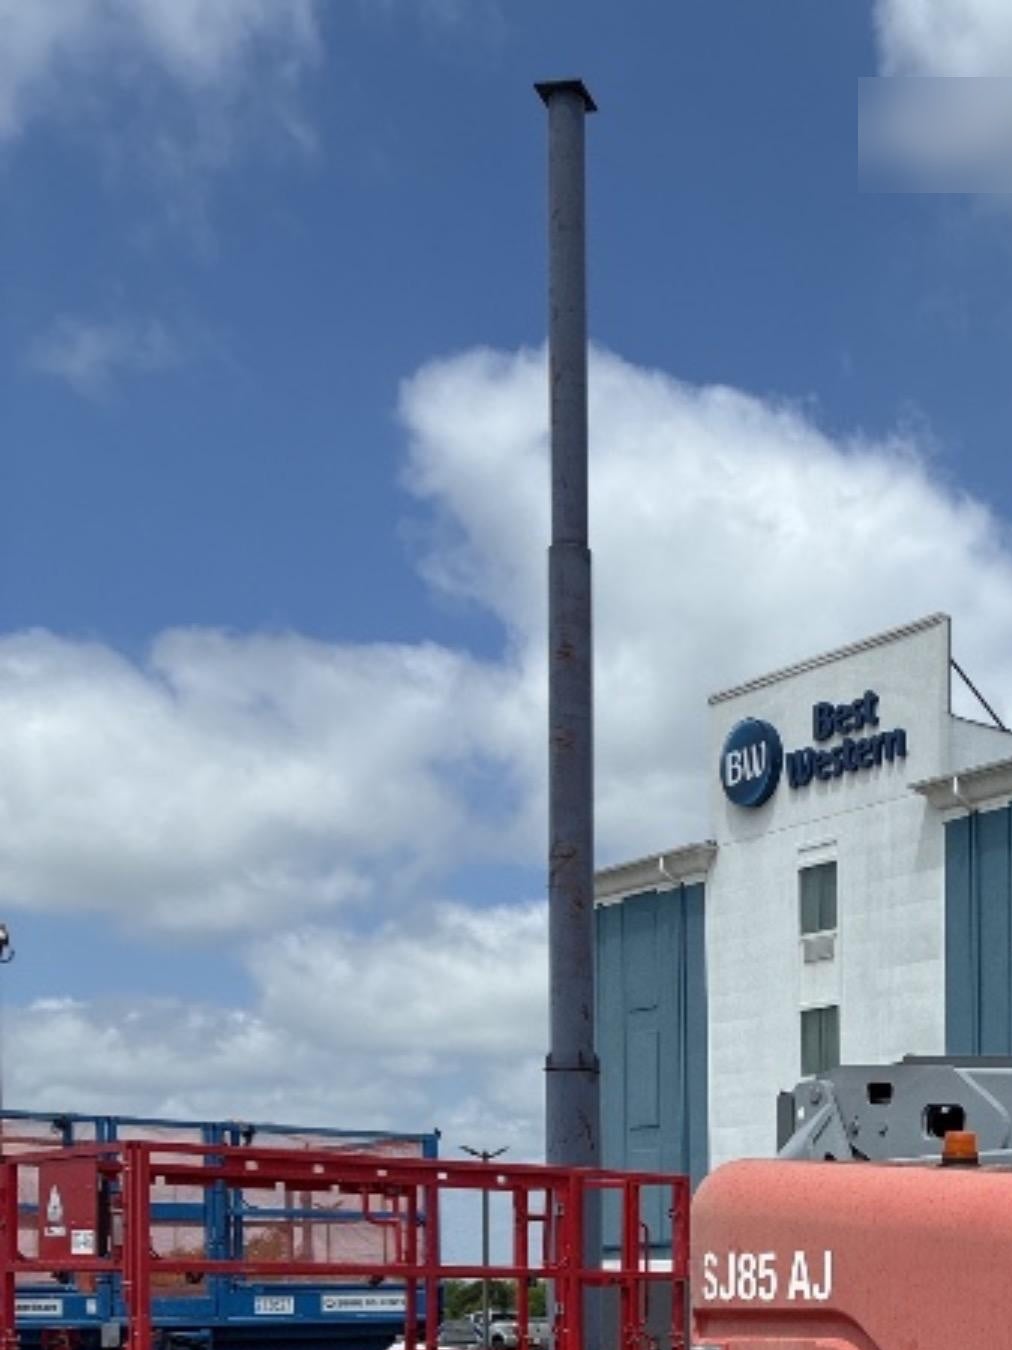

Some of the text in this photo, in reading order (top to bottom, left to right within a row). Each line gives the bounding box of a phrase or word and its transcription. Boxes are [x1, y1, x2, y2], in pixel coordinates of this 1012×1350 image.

[812, 689, 880, 741] Best
[725, 740, 768, 786] BW
[785, 727, 907, 789] Western
[703, 1250, 832, 1300] SJ85 AJ
